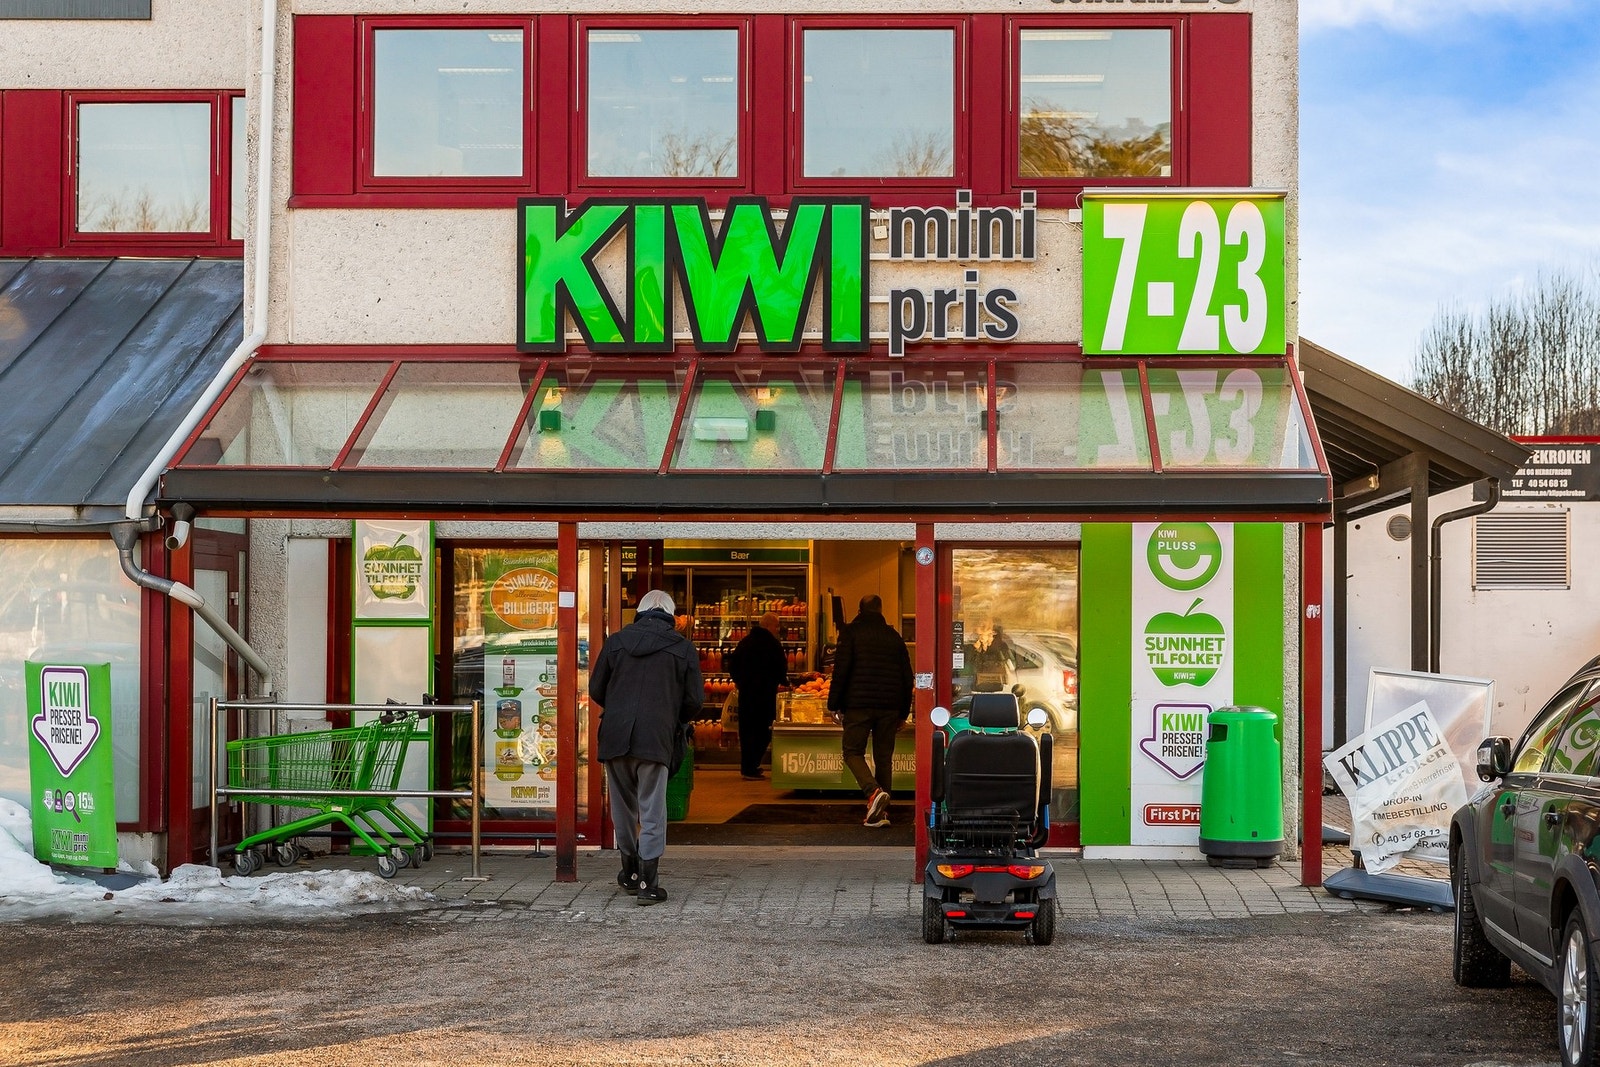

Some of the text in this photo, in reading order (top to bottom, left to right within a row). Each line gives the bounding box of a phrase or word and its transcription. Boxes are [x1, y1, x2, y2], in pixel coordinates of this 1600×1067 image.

[889, 189, 1037, 262] mini
[517, 197, 870, 354] KIWI
[1102, 200, 1268, 355] 7-23
[889, 269, 1020, 357] pris
[1525, 449, 1591, 465] EKROKEN
[1511, 479, 1568, 488] TLF 40 54 68 13
[1157, 529, 1178, 539] KIWI
[1157, 541, 1197, 551] PLUSS
[730, 551, 750, 560] Bær
[364, 562, 423, 574] SUNNHET
[365, 574, 422, 584] TIL FOLKET
[503, 573, 556, 594] SUNNERE
[503, 601, 556, 615] BILLIGERE
[1144, 636, 1226, 652] SUNNHET
[1147, 653, 1223, 665] TIL FOLKET
[1173, 672, 1189, 680] KIWI
[48, 681, 81, 708] KIWI
[50, 708, 82, 727] PRESSER
[1162, 713, 1203, 732] KIWI
[50, 727, 82, 745] PRISENE!
[1162, 732, 1203, 745] PRESSER
[1162, 745, 1203, 758] PRISENE!
[1338, 711, 1442, 791] KLIPPE
[780, 752, 815, 774] 15%
[816, 760, 844, 771] BONUS
[1383, 747, 1447, 786] kroken
[510, 786, 538, 799] KIWI
[1382, 793, 1423, 807] DROP-IN
[1150, 808, 1200, 821] First Pri
[51, 828, 89, 851] KIWI mini
[1387, 834, 1399, 844] 40
[73, 843, 88, 853] pris
